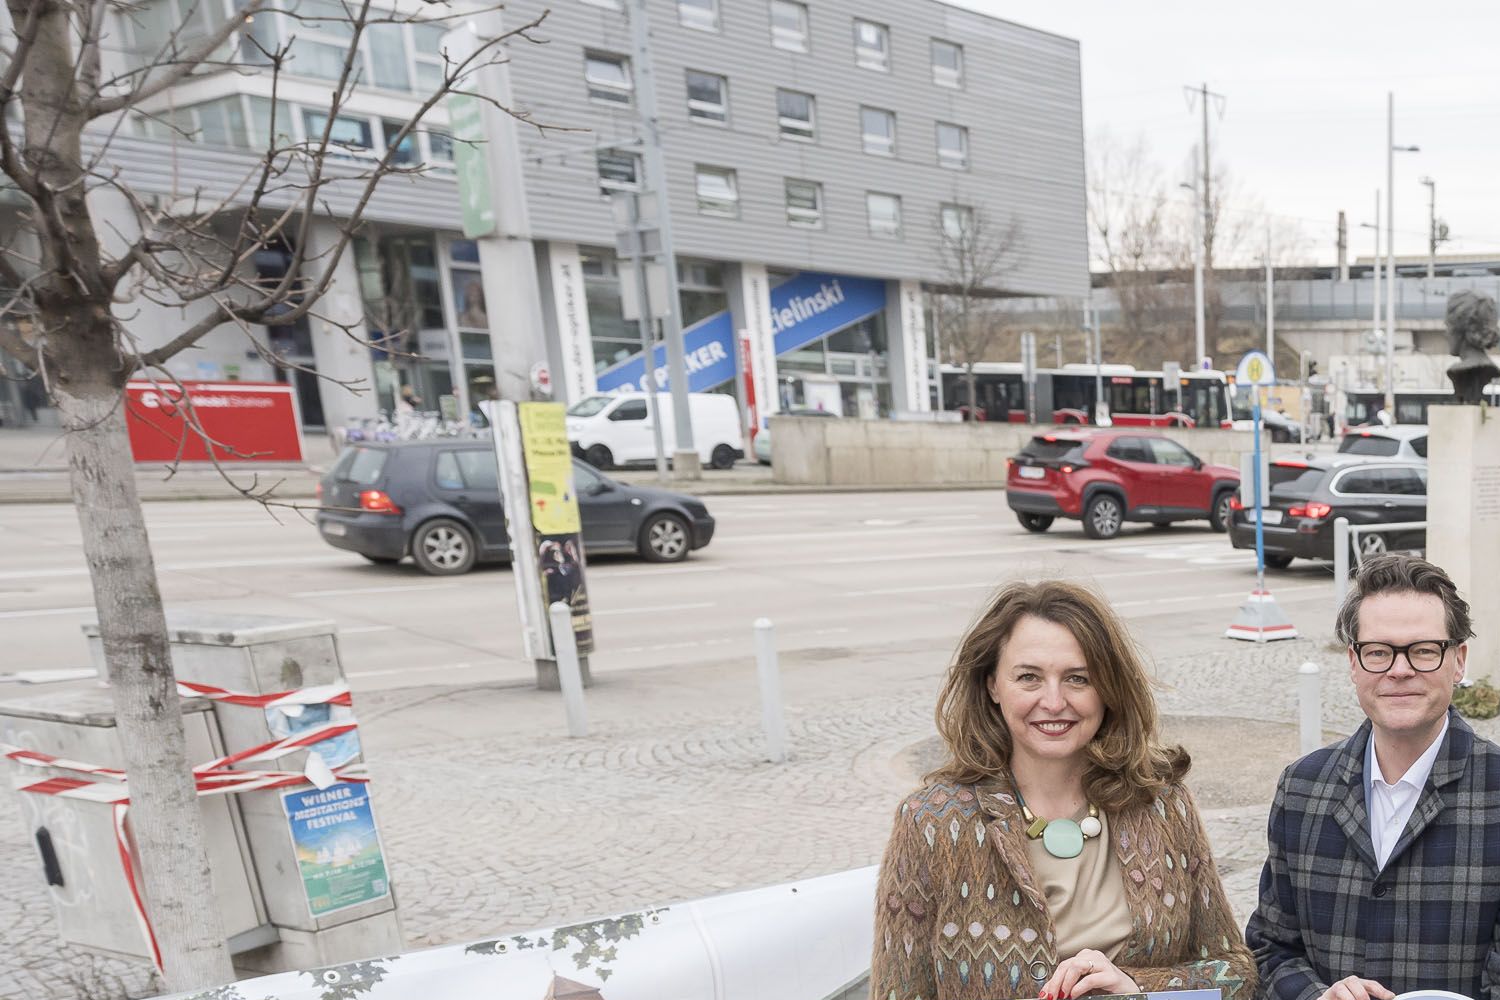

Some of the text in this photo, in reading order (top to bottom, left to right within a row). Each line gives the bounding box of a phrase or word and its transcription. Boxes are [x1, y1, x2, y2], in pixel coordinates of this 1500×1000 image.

[771, 279, 845, 335] ielinski
[301, 787, 352, 807] WIENER
[306, 811, 357, 830] FESTIVAL
